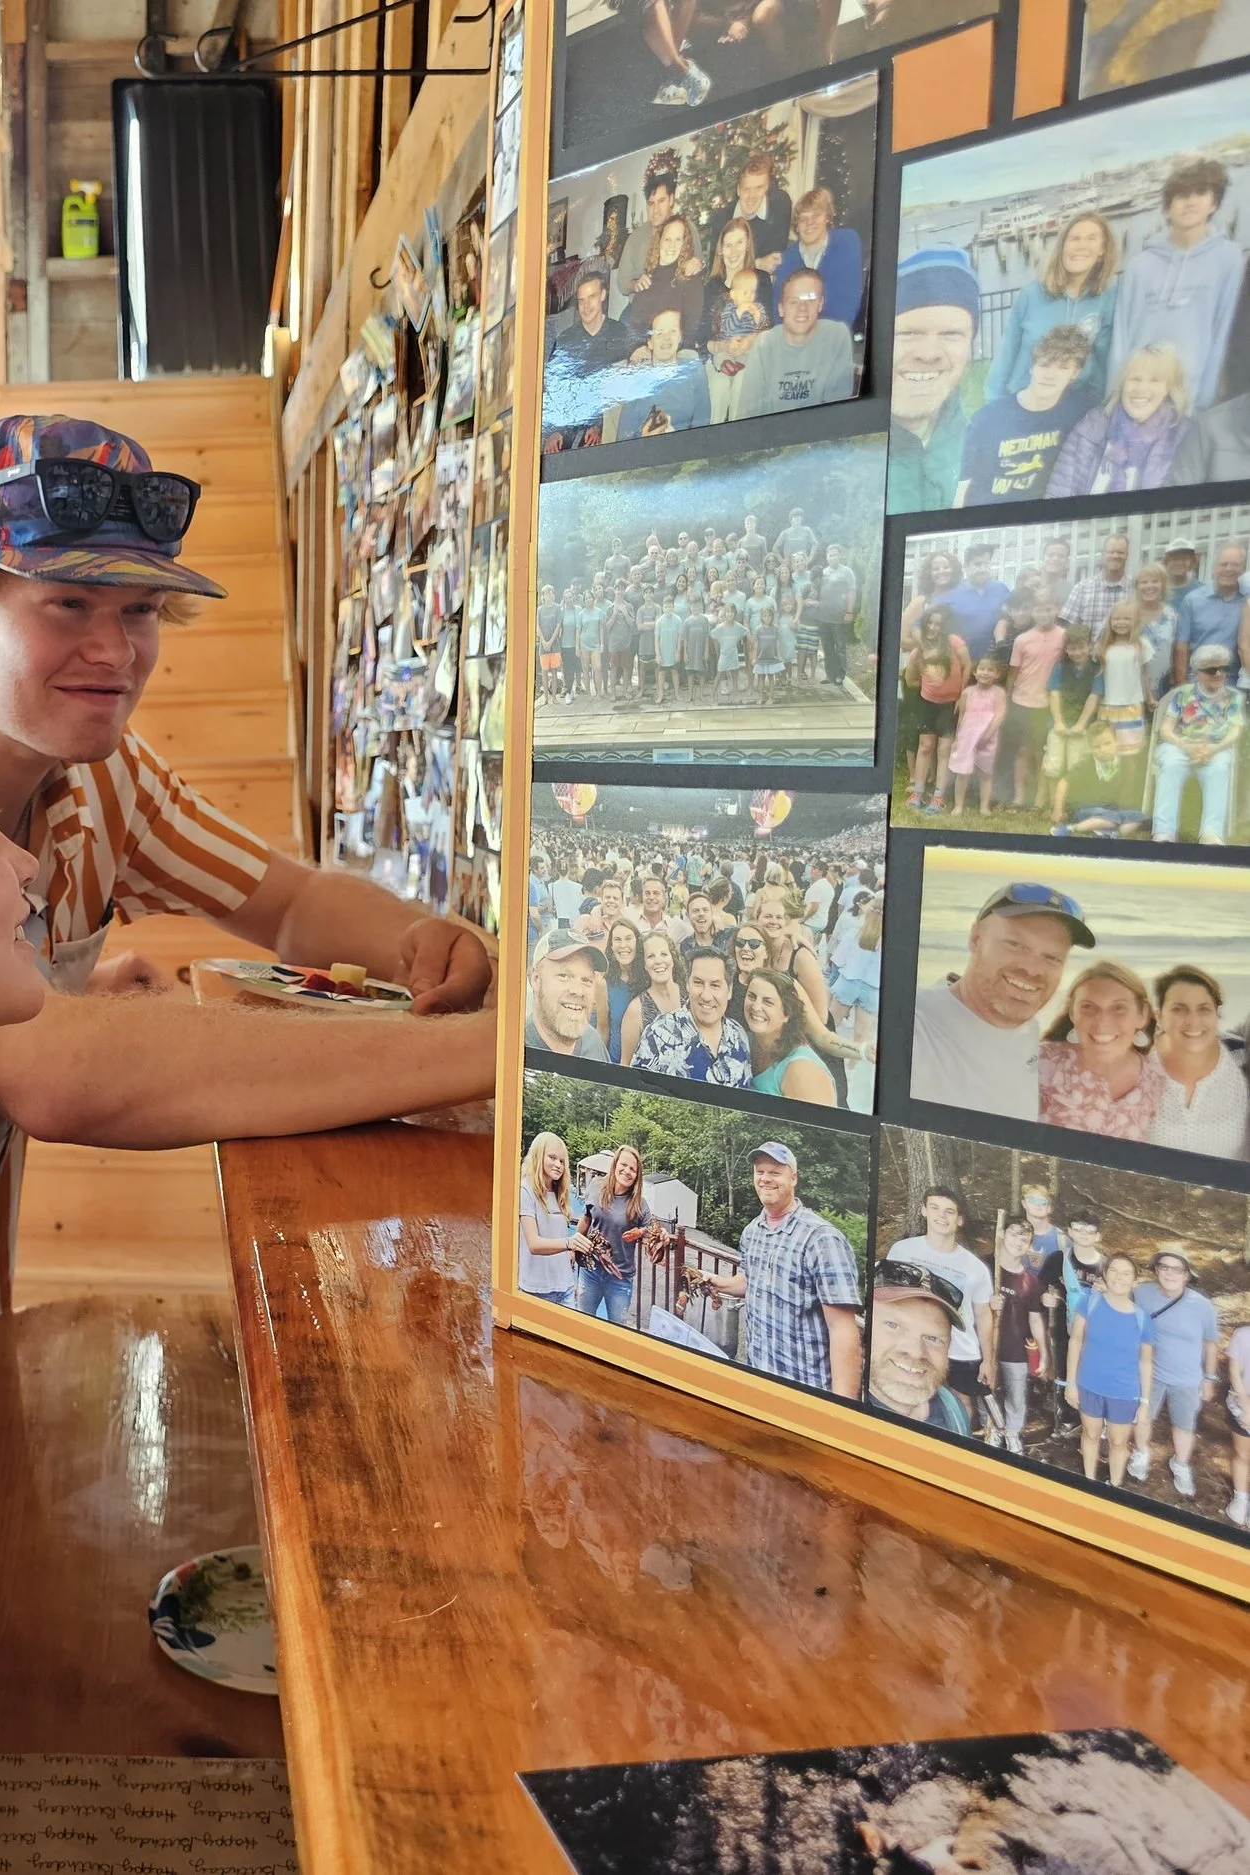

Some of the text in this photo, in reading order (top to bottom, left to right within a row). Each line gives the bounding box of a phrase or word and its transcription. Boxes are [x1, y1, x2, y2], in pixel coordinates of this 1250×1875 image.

[778, 379, 815, 391] TOMMY
[779, 390, 810, 401] JEANS
[44, 1774, 101, 1792] Happy
[112, 1773, 193, 1796] Birthday
[195, 1775, 255, 1796] Happy
[33, 1798, 117, 1820] Birthday
[119, 1803, 177, 1823] Happy
[188, 1800, 271, 1825] Birthday
[38, 1825, 99, 1846] Happy
[110, 1826, 195, 1853] Birthday
[197, 1832, 259, 1850] Happy
